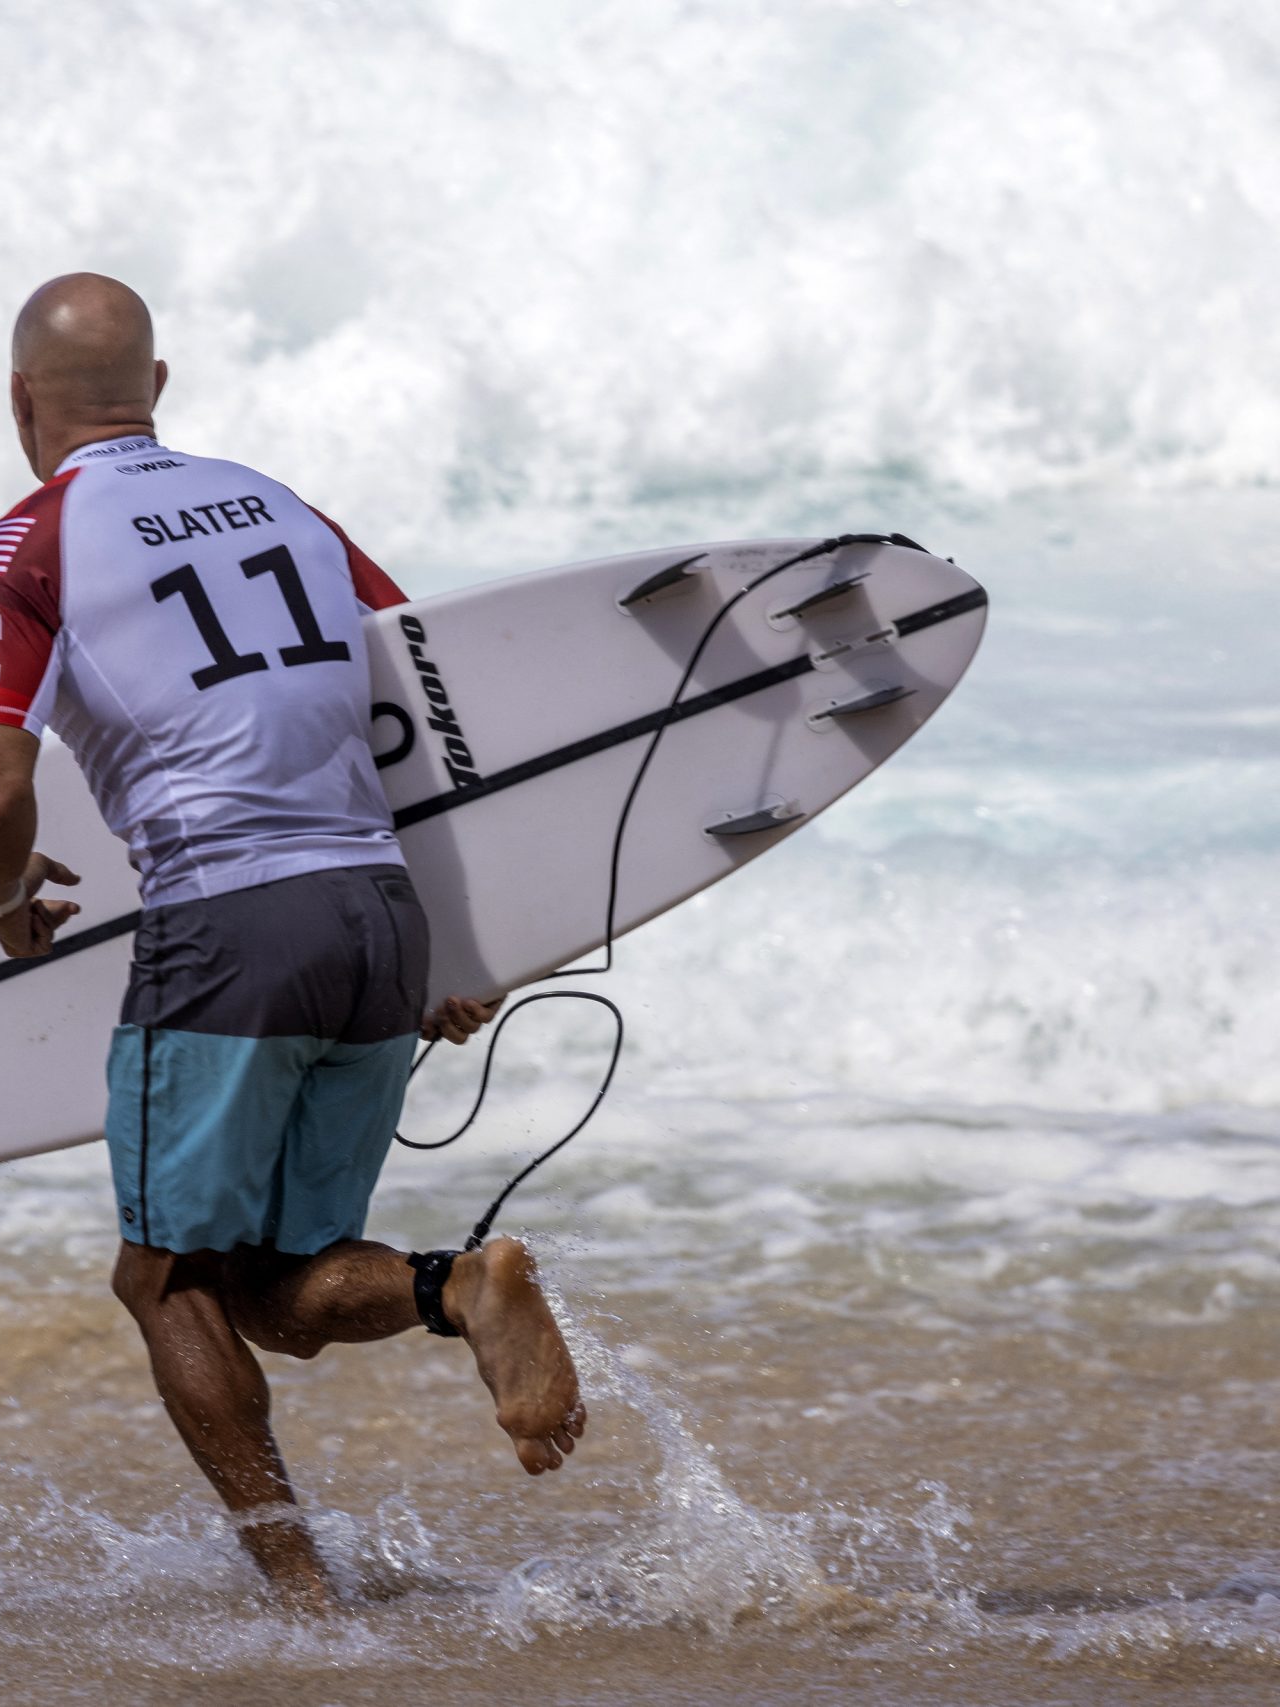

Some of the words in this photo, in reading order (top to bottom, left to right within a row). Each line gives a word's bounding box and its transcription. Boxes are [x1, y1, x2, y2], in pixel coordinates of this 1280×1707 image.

[137, 459, 185, 472] WSL
[132, 495, 275, 546] SLATER
[150, 544, 351, 691] 11
